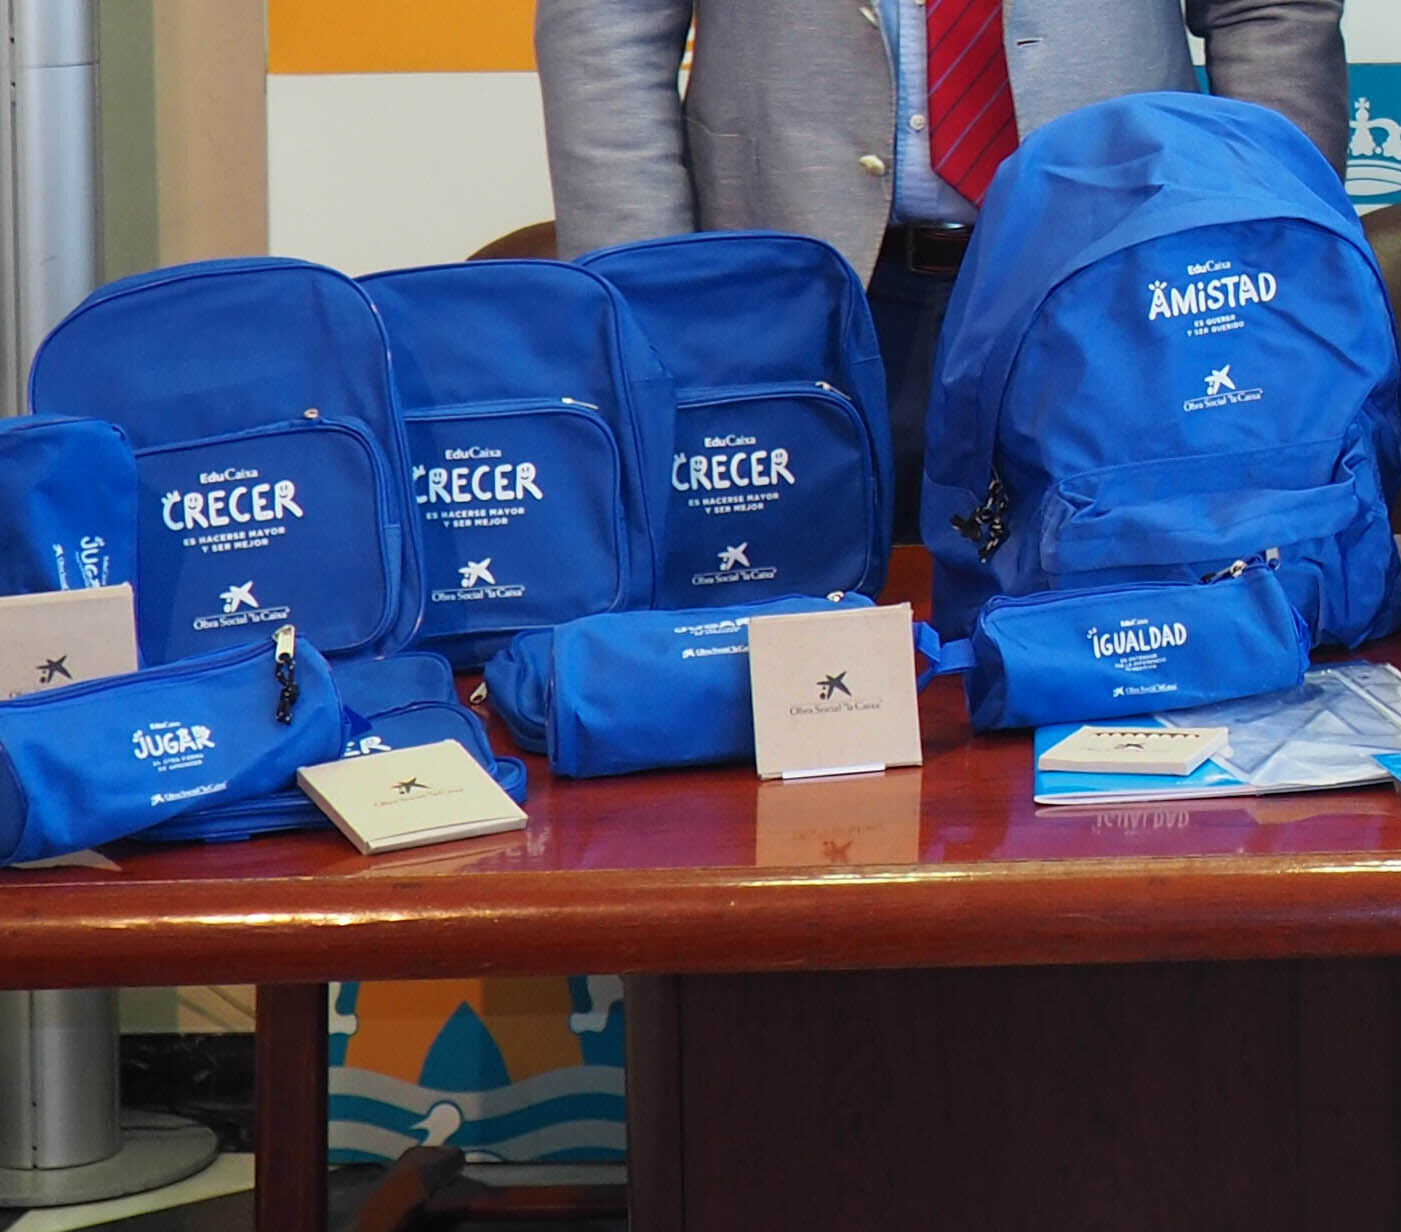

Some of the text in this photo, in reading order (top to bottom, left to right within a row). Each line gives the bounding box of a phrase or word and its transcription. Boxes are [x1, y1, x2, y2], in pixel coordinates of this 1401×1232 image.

[704, 434, 756, 448] EduCaixa
[445, 447, 501, 460] EduCaixa
[200, 468, 259, 484] EduCaixa
[671, 448, 796, 491] CRECER
[161, 480, 303, 531] CRECER
[702, 495, 745, 506] HACERSE
[746, 492, 779, 501] MAYOR
[441, 508, 486, 519] HACERSE
[489, 506, 525, 516] MAYOR
[714, 506, 731, 514] SER
[733, 503, 764, 512] MEJOR
[453, 519, 472, 528] SER
[475, 517, 508, 526] MEJOR
[199, 531, 246, 544] HACERSE
[248, 526, 285, 538] MAYOR
[212, 542, 231, 552] SER
[234, 538, 269, 549] MEJOR
[1087, 622, 1187, 658] IGUALDAD
[132, 725, 215, 759] JUGAR
